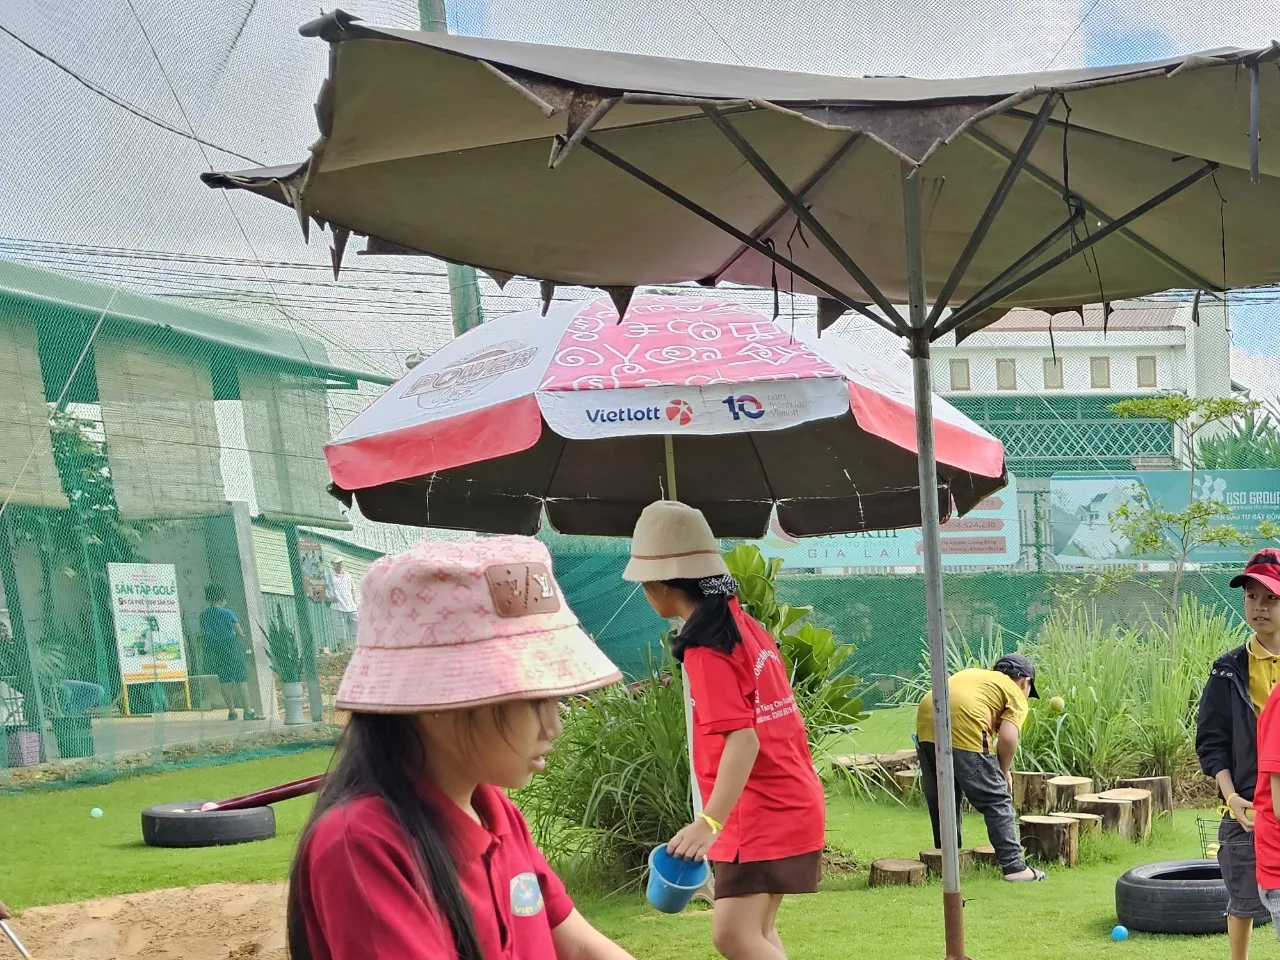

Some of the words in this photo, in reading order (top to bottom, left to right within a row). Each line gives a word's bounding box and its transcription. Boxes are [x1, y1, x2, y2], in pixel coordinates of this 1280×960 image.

[403, 350, 535, 395] POWER
[586, 406, 661, 423] Vietlott
[722, 394, 765, 421] 10
[1226, 491, 1247, 505] BSO
[808, 548, 846, 558] GIA
[863, 548, 901, 558] LAI
[152, 585, 176, 596] GOLF
